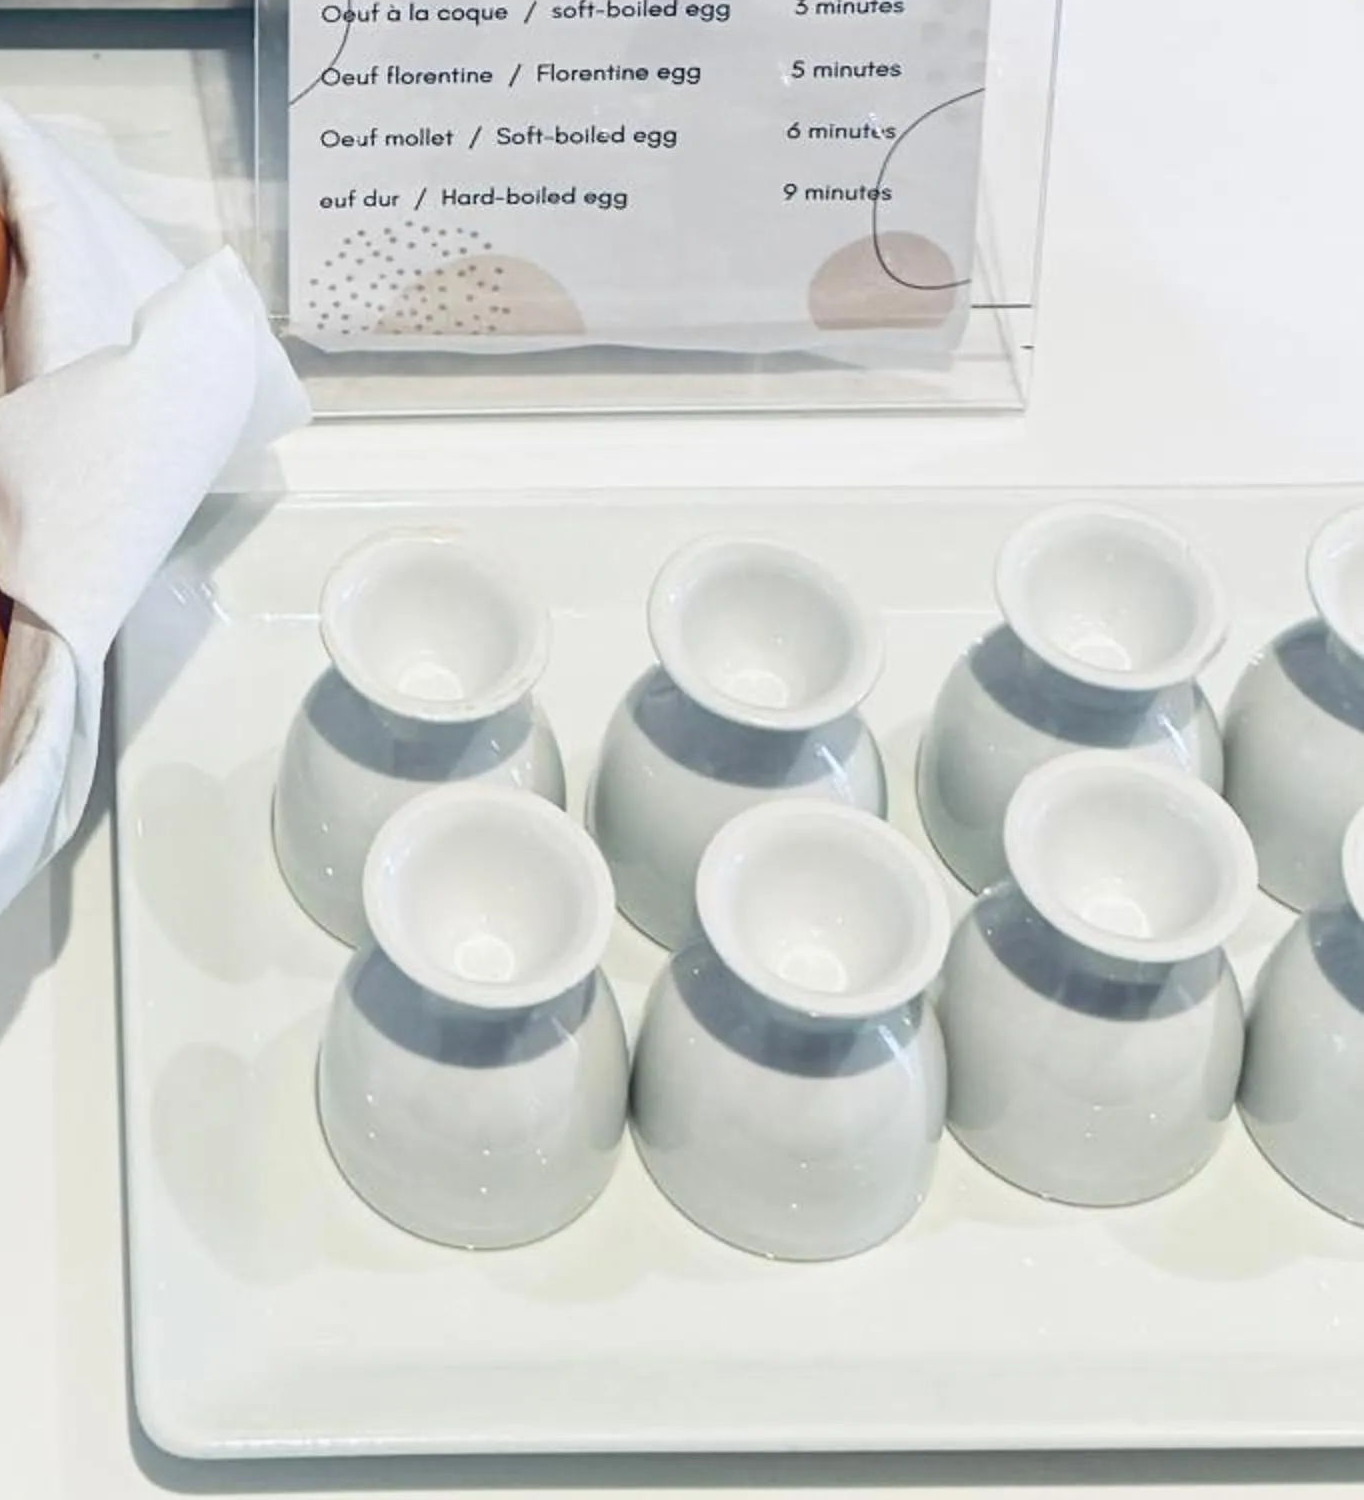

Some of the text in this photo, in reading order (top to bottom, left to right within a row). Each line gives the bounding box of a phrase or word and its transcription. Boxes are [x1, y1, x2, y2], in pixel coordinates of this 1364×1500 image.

[320, 3, 381, 25] Oeuf
[386, 3, 402, 23] à
[408, 2, 434, 22] la
[436, 6, 509, 27] coque
[523, 0, 538, 25] /
[684, 3, 731, 23] egg
[320, 62, 701, 89] Oeuf florentine / Florentine egg
[790, 59, 903, 80] 5 minutes
[319, 123, 678, 150] Oeuf mollet / Soft-boiled egg
[785, 121, 802, 140] 6
[319, 185, 629, 212] euf dur / Hard-boiled egg
[782, 182, 893, 202] 9 minutes
